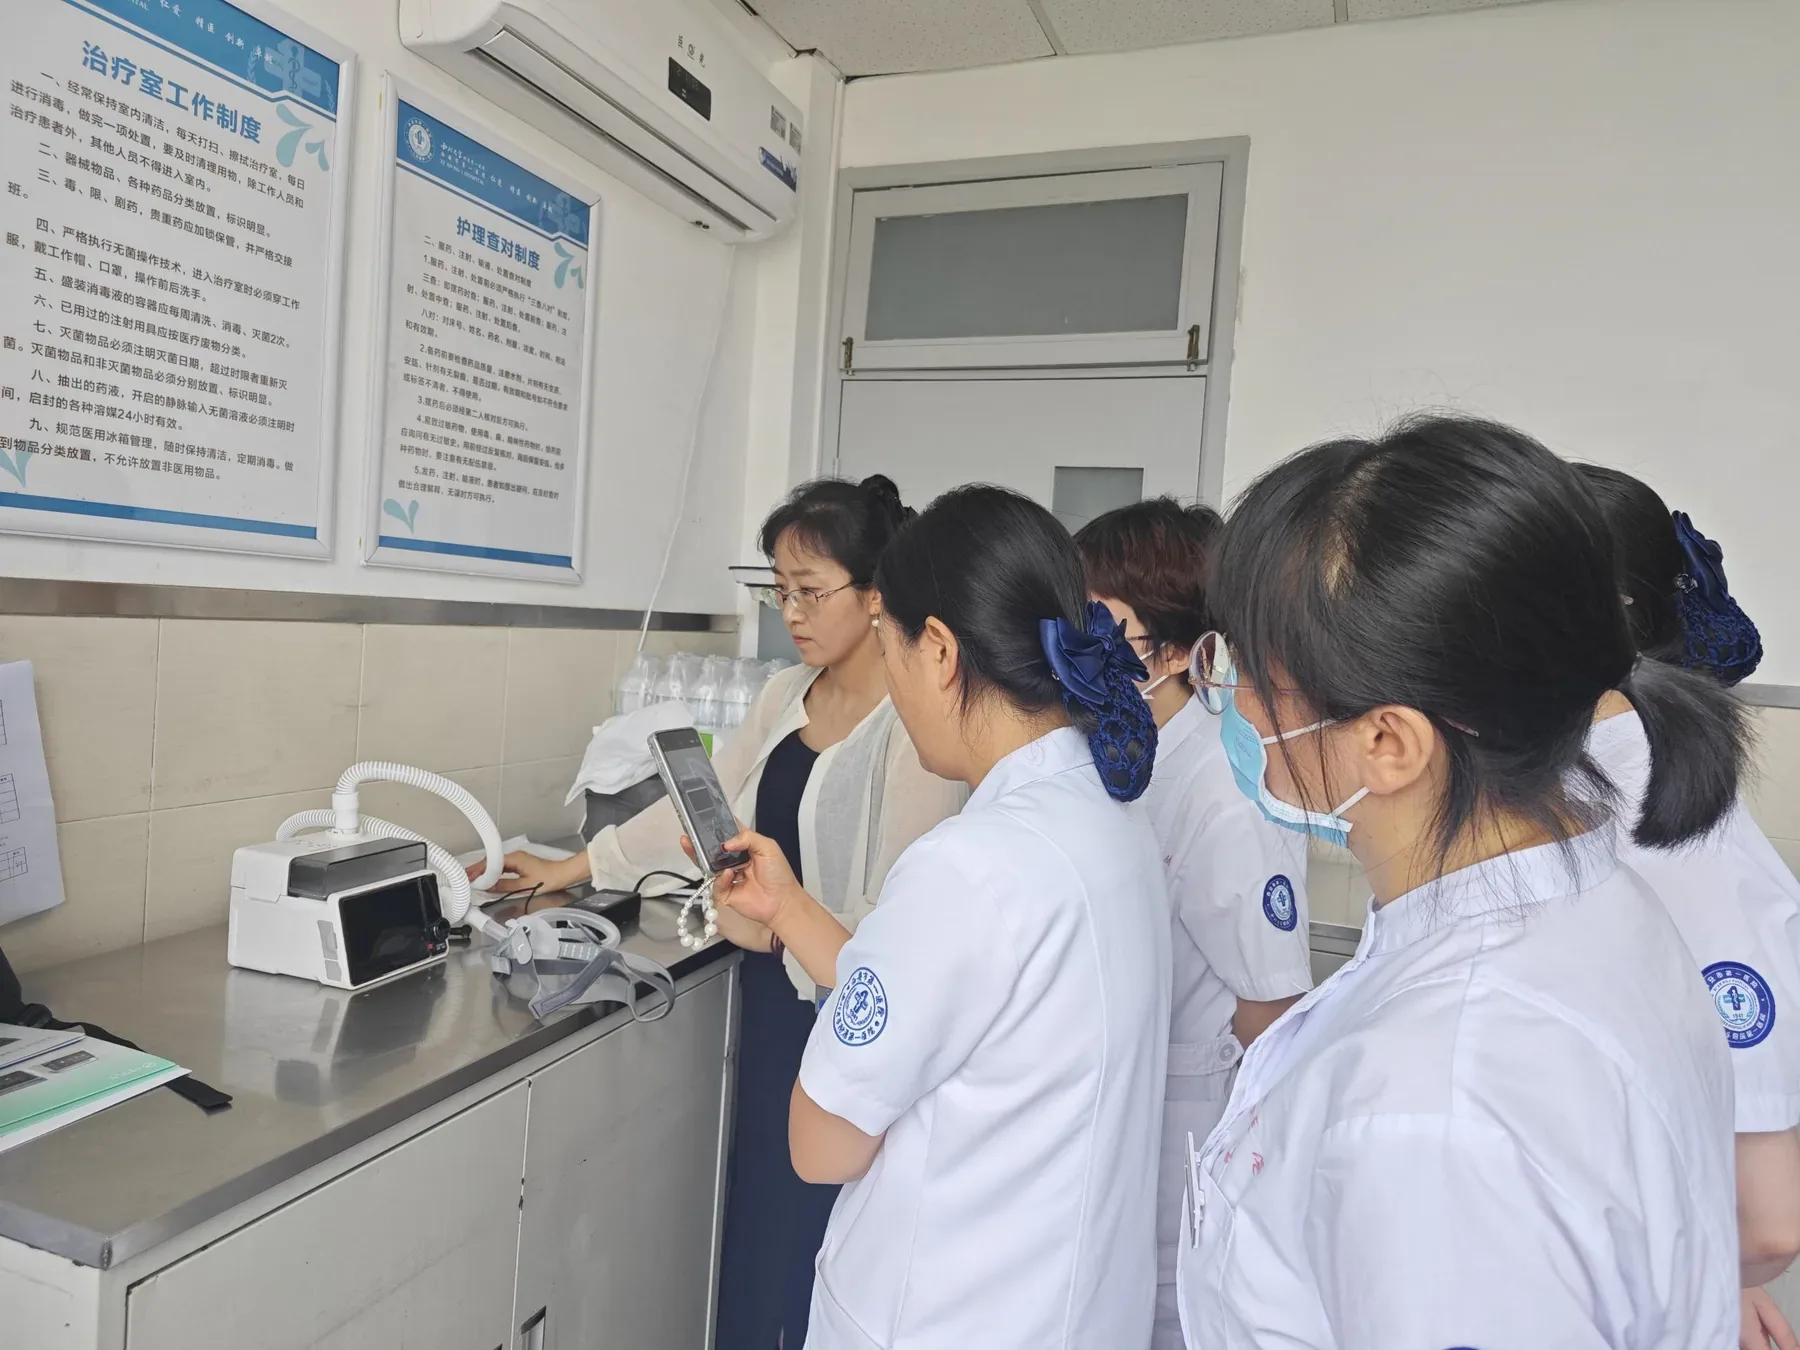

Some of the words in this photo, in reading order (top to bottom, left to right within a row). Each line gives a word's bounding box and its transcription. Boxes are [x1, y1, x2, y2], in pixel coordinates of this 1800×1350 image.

[225, 32, 245, 50] 创新
[82, 40, 260, 143] 治疗室工作制度
[10, 103, 210, 191] 治疗患者外，其他人员不得进入室内。
[7, 181, 27, 198] 班。
[6, 232, 206, 301] 服，戴工作帽、口罩，操作前后洗手。
[36, 217, 299, 309] 四、严格执行无菌操作技术，进入治疗室时必须穿工作
[456, 216, 539, 270] 护理查对制度
[33, 294, 245, 358] 六、已用过的注射用具应按医疗废物分类。
